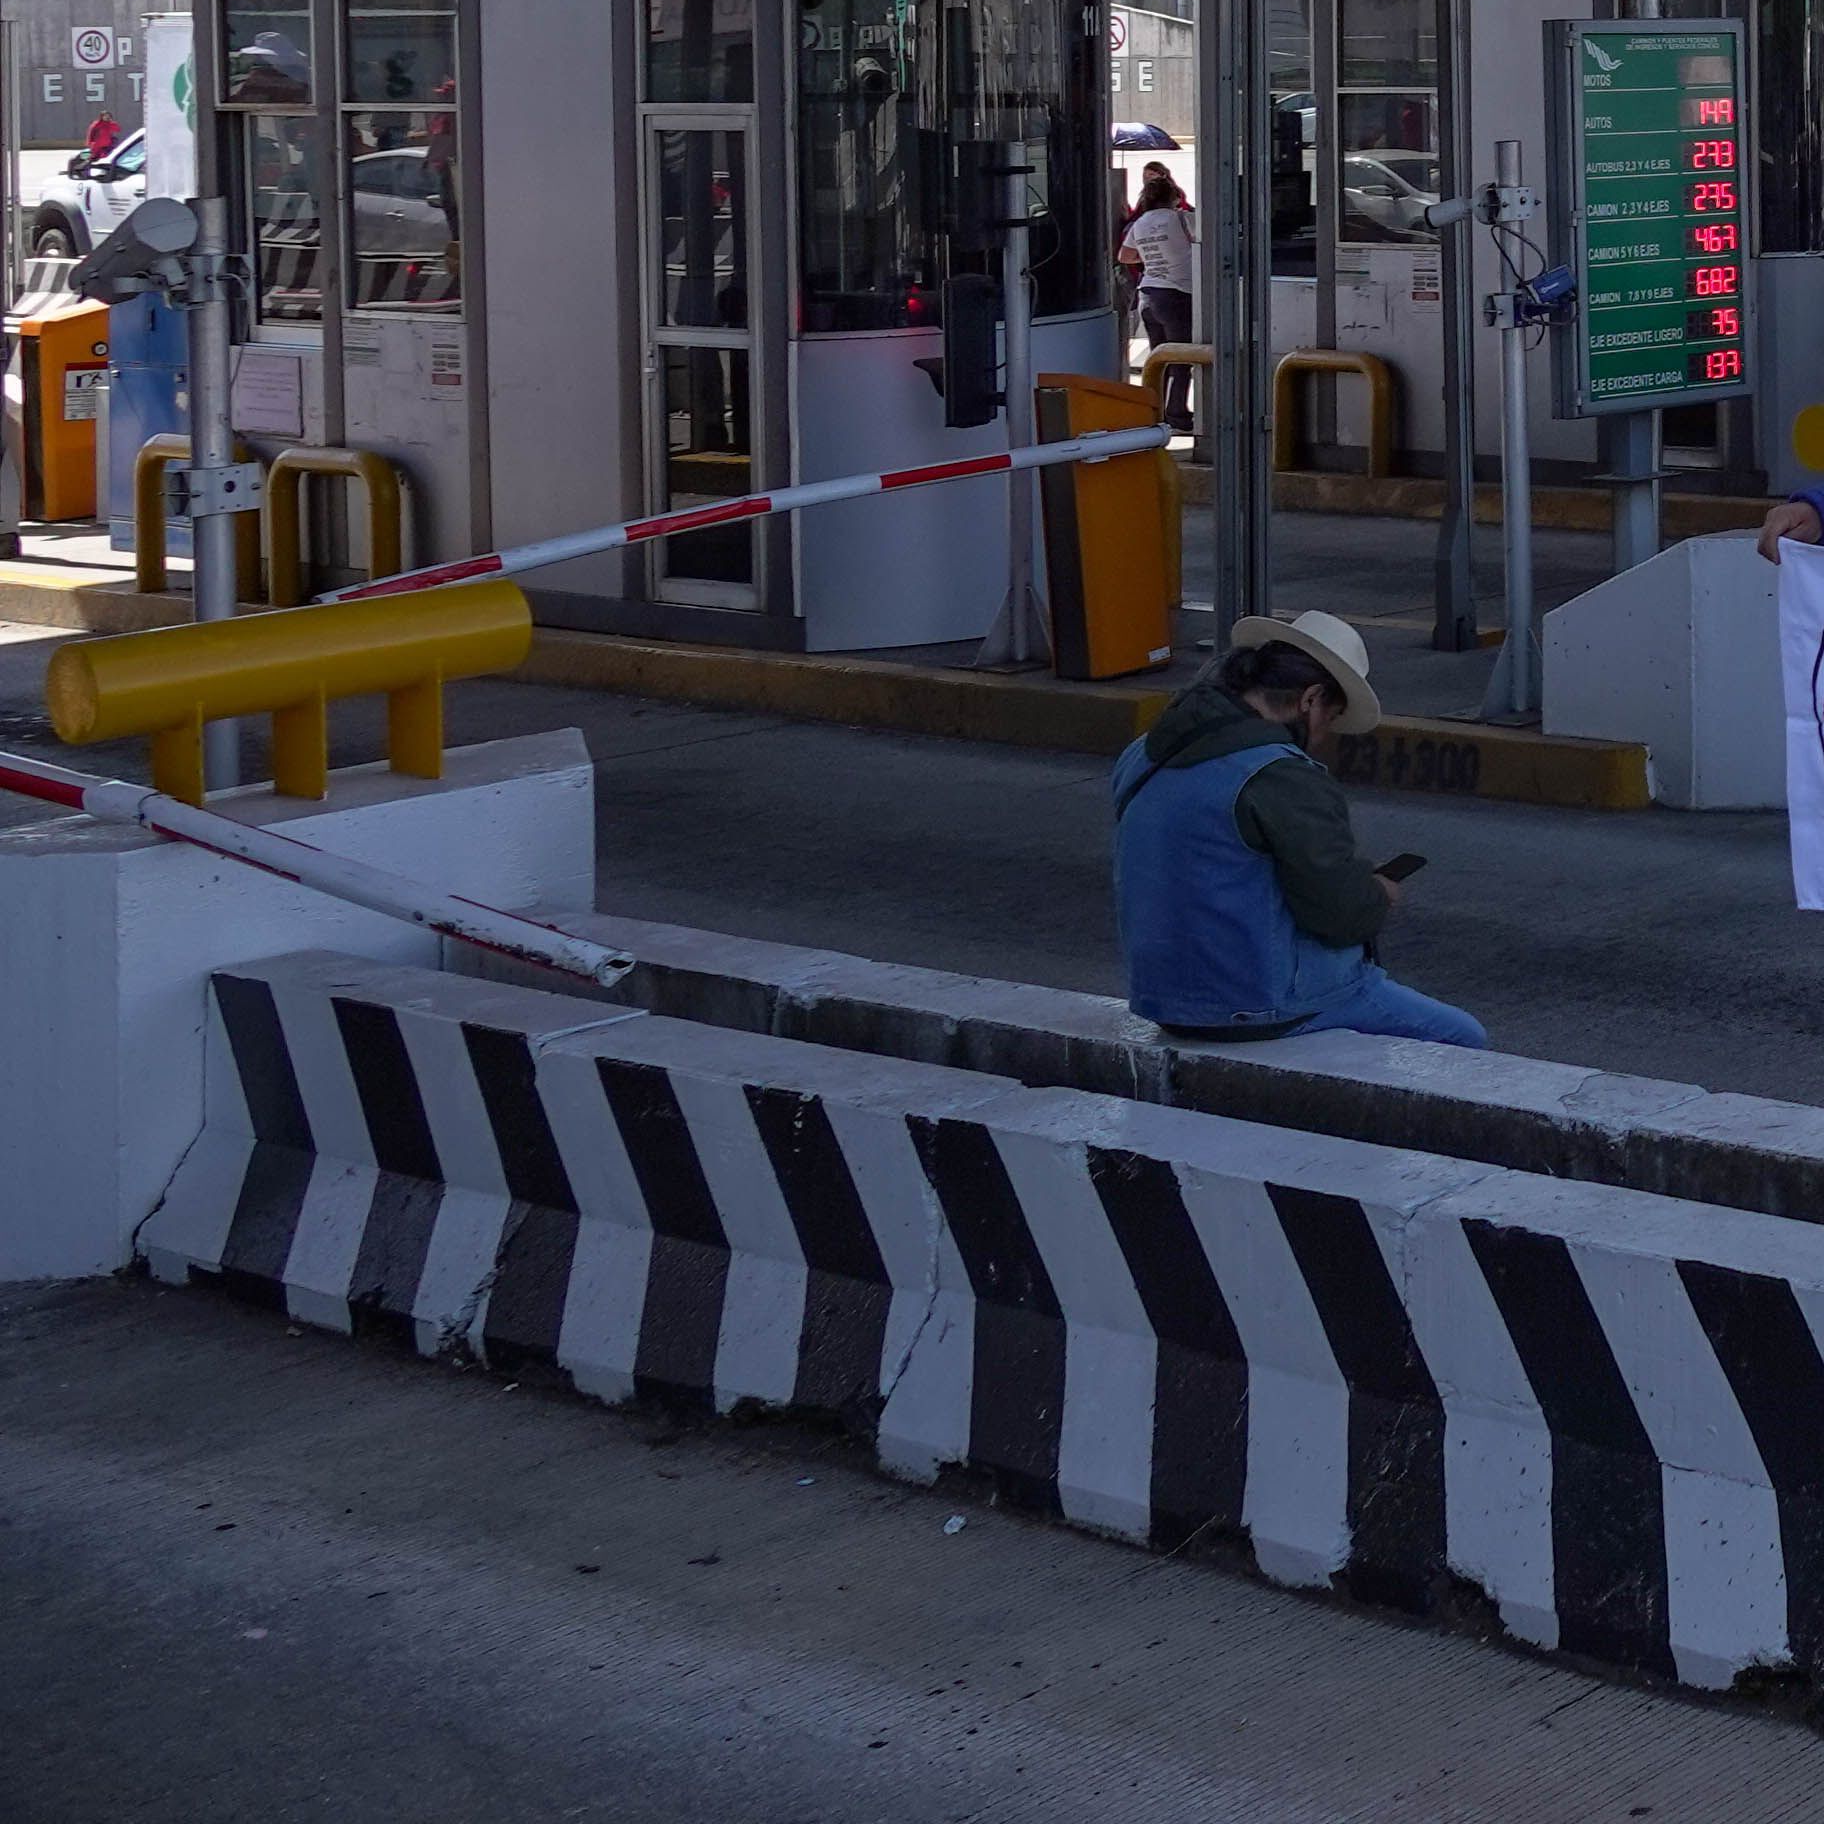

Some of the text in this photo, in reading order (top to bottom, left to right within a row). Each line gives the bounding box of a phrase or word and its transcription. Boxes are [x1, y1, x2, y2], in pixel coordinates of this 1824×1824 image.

[83, 36, 102, 52] 40
[1584, 74, 1612, 87] MOTOS
[1699, 99, 1736, 125] 149
[1585, 117, 1613, 129] AUTOS
[1693, 140, 1736, 169] 273
[1586, 162, 1624, 174] AUTOBUS
[1637, 161, 1644, 171] Y
[1644, 161, 1650, 171] 4
[1650, 159, 1671, 170] EJES
[1693, 182, 1737, 211] 275
[1587, 204, 1618, 217] CAMION
[1637, 202, 1643, 213] Y
[1643, 202, 1650, 213] 4
[1650, 200, 1670, 212] EJES
[1694, 225, 1737, 252] 467
[1588, 248, 1619, 260] CAMION
[1621, 247, 1626, 257] 5
[1627, 246, 1633, 257] Y
[1640, 244, 1660, 256] EJES
[1696, 266, 1737, 295] 682
[1589, 291, 1621, 304] CAMION
[1640, 289, 1647, 300] Y
[1647, 289, 1653, 299] 9
[1654, 287, 1674, 298] EJES
[1712, 308, 1739, 336] 75
[1591, 328, 1684, 348] EJE EXCEDENTE LIGERO
[1706, 350, 1739, 379] 137
[1592, 371, 1684, 392] EJE EXCEDENTE CARGA
